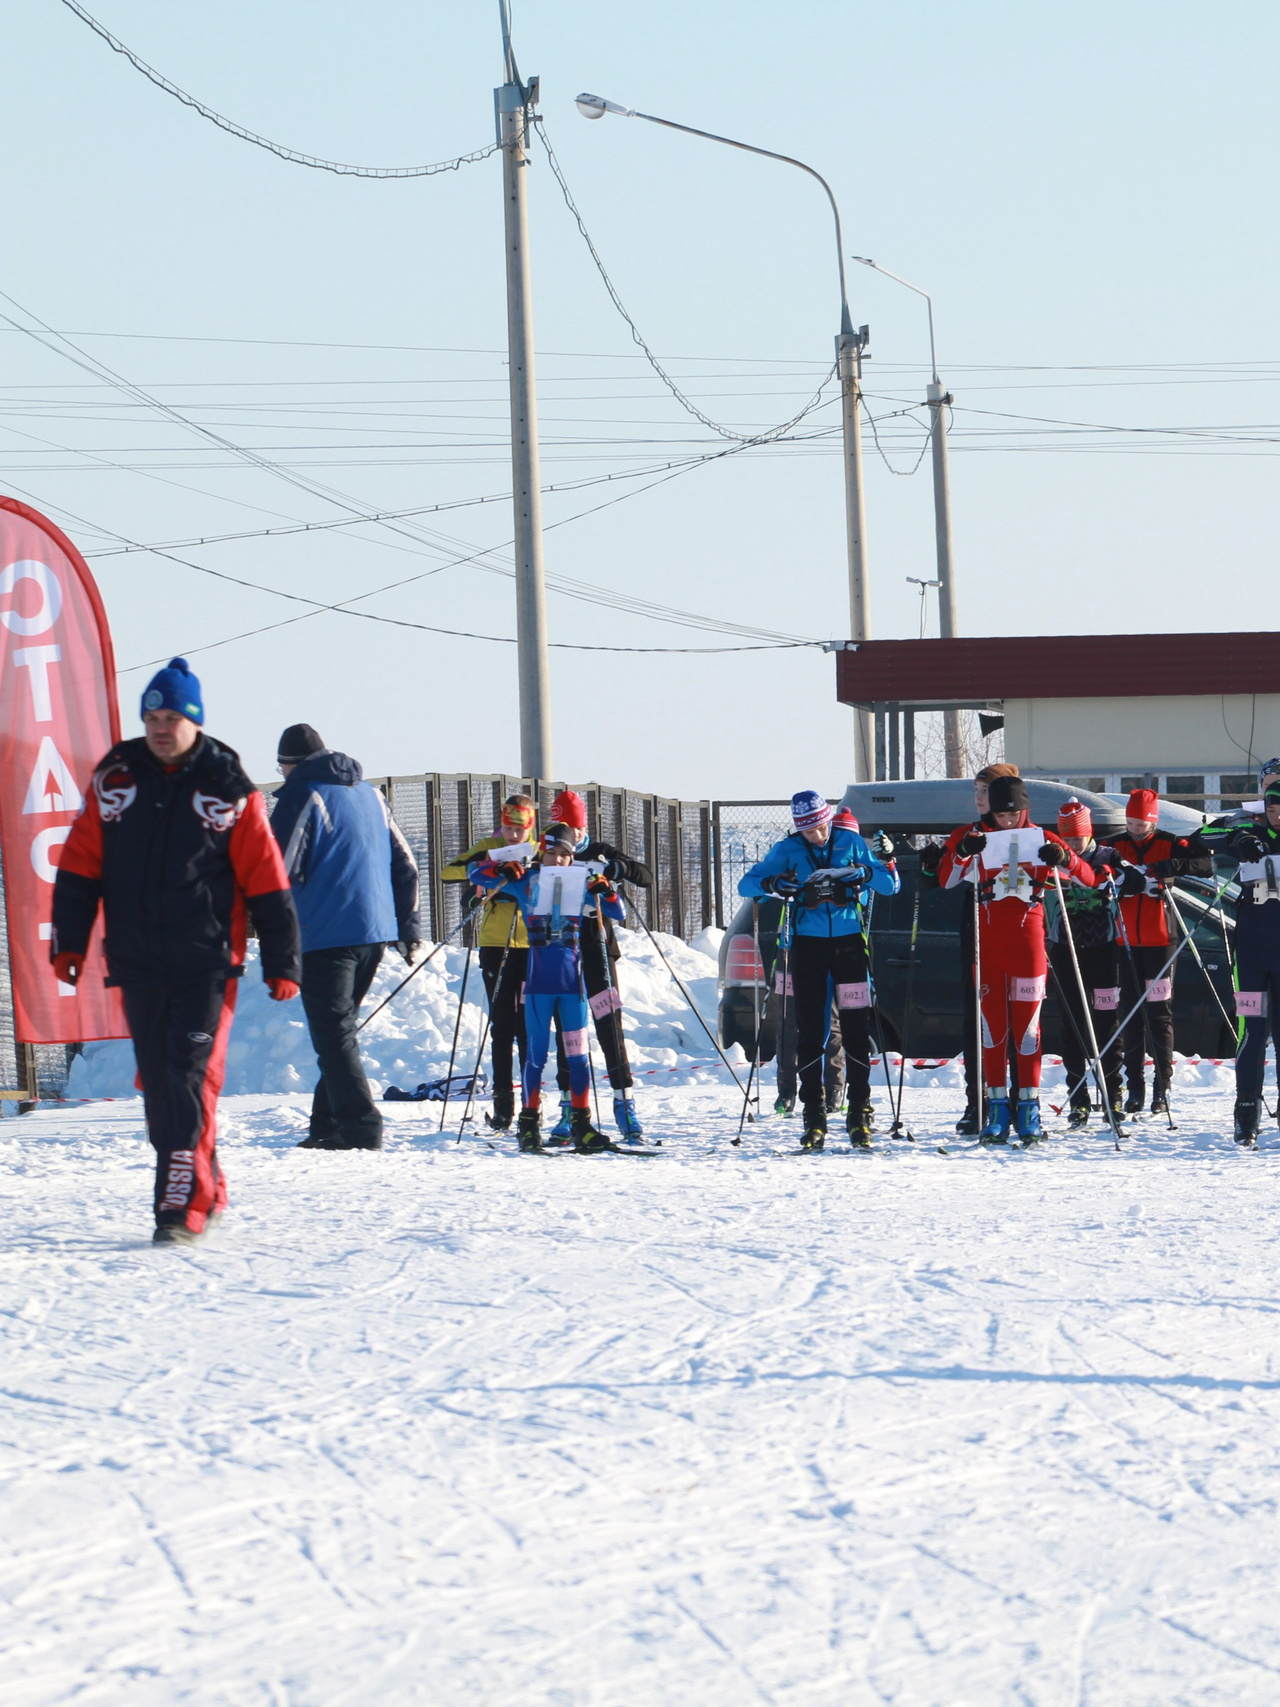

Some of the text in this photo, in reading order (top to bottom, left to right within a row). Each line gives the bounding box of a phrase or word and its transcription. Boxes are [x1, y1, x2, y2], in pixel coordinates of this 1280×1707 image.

[871, 796, 896, 804] THULE
[1150, 986, 1167, 994] 13.1
[843, 991, 865, 1000] 602.1
